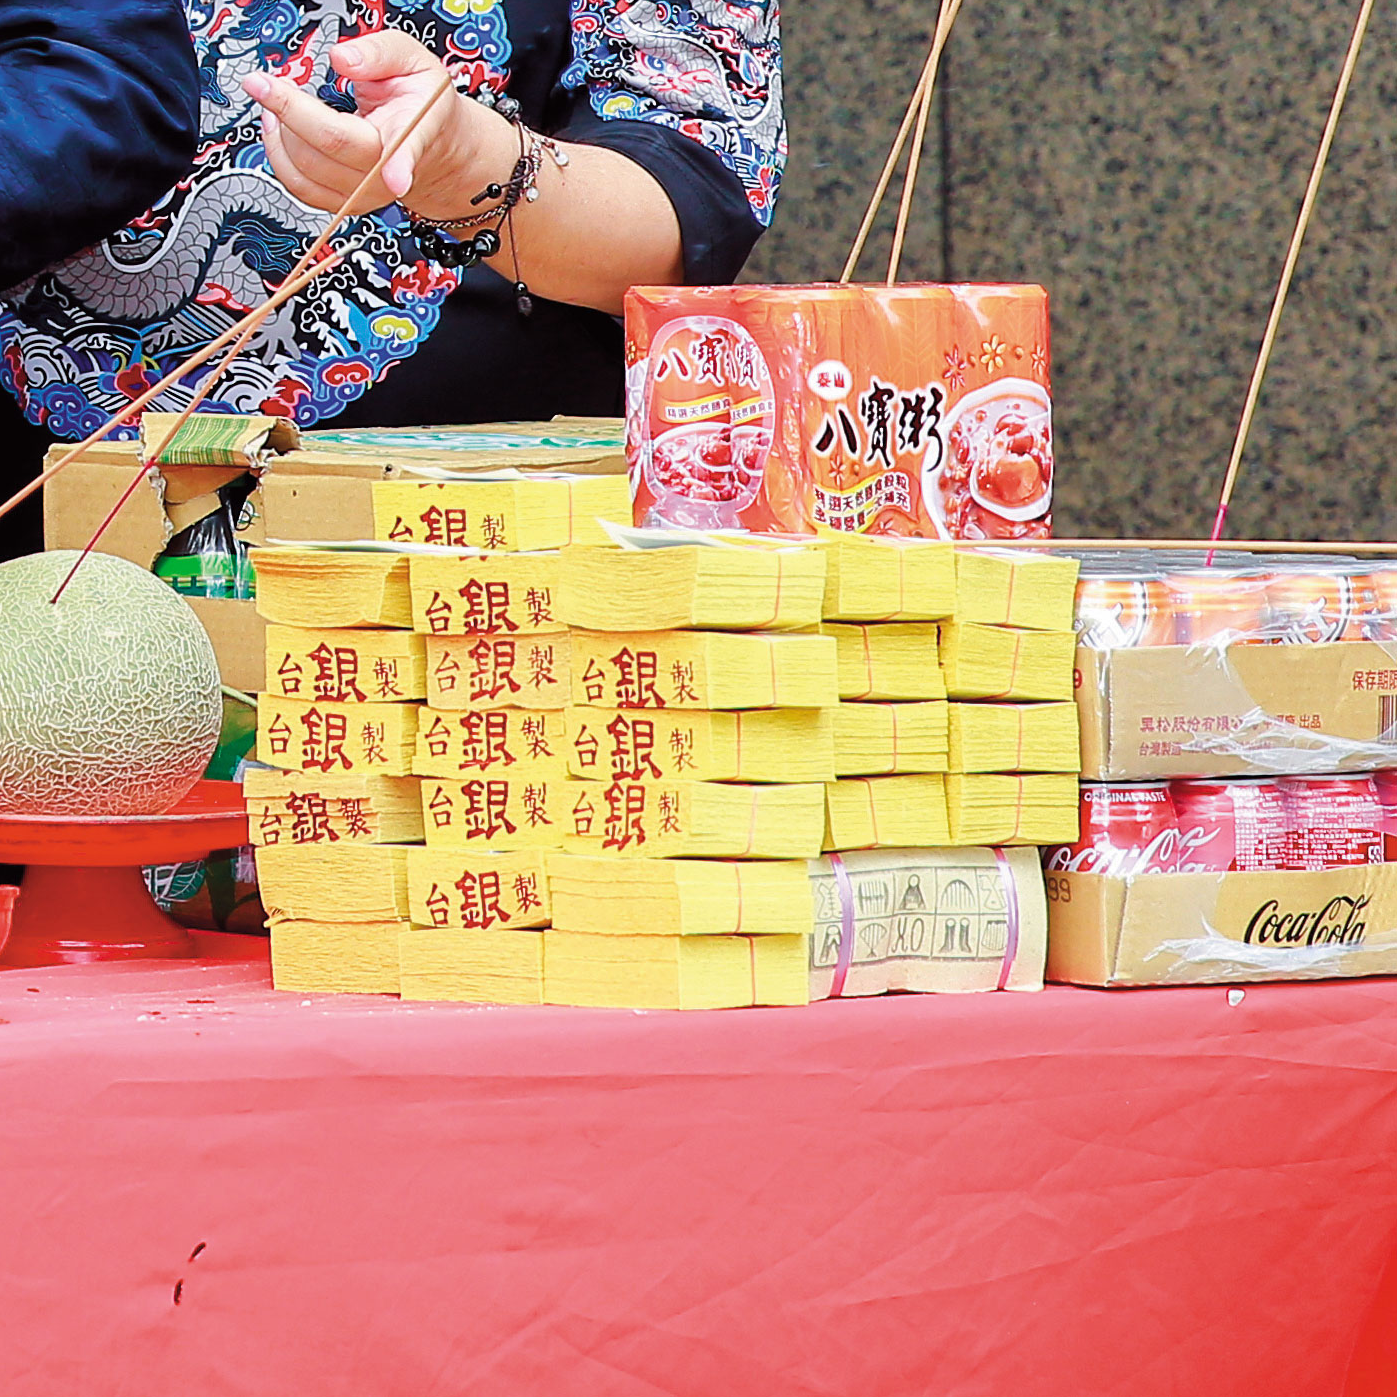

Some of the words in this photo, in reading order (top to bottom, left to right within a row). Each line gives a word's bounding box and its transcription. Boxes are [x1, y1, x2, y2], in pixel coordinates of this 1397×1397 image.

[817, 371, 846, 389] 泰山
[815, 381, 944, 472] 八寶粥
[425, 579, 554, 633] 台銀製
[277, 642, 403, 701] 台銀製
[428, 640, 558, 699] 台銀製
[582, 648, 699, 708] 台銀製
[267, 708, 388, 770] 台銀製
[425, 711, 554, 770] 台銀製
[574, 715, 698, 780] 台銀製
[429, 780, 554, 839] 台銀製
[573, 783, 683, 851] 台銀製
[426, 871, 541, 929] 台銀製
[1243, 893, 1374, 946] Coca-Cola
